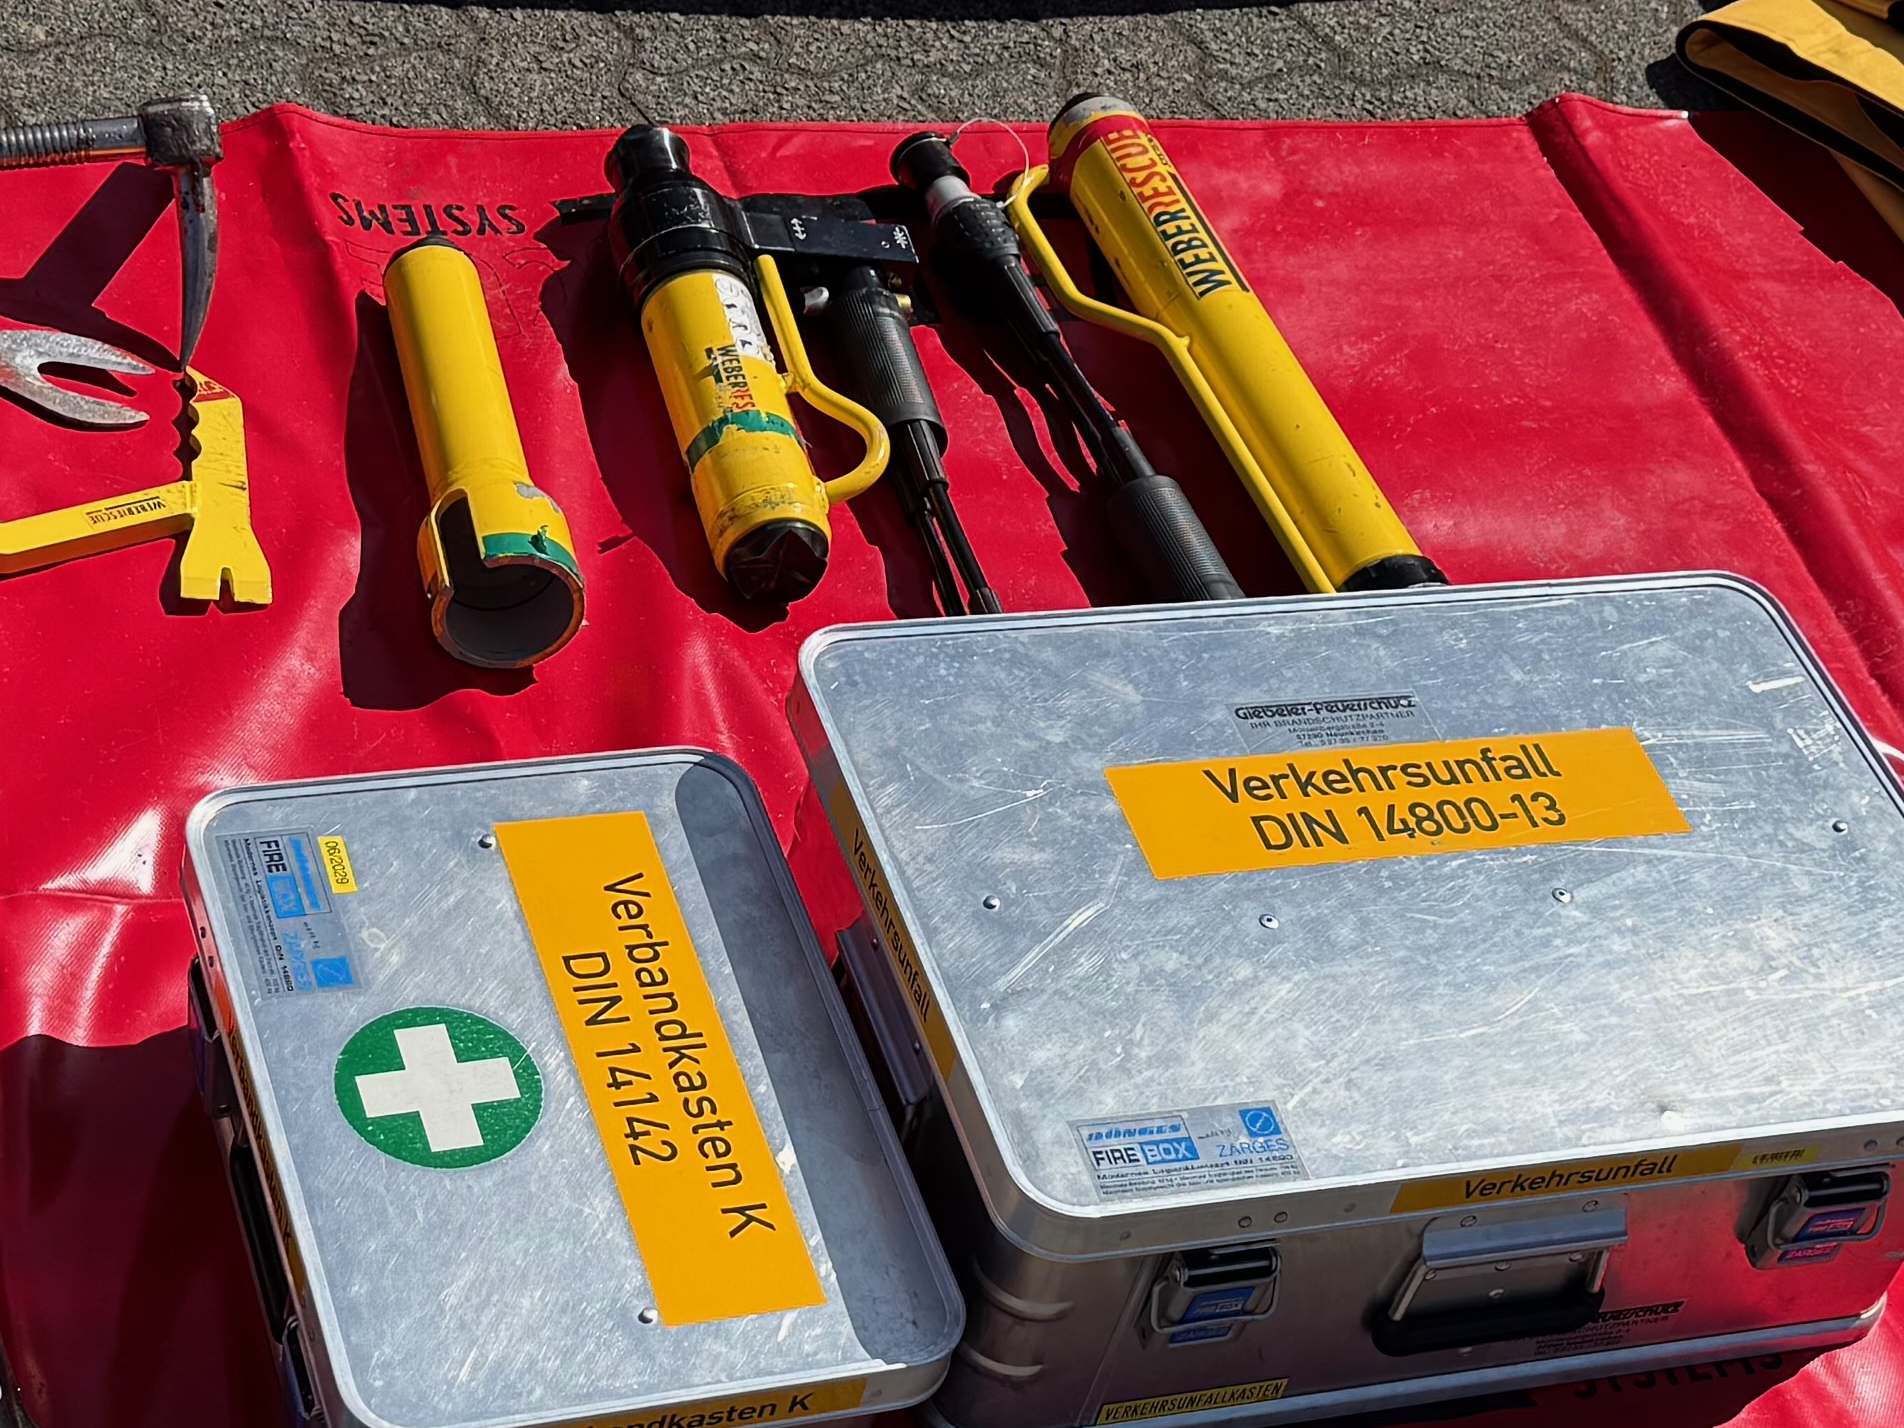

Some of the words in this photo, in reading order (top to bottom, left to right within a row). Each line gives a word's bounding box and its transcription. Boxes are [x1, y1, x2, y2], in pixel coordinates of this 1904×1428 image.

[330, 191, 527, 238] SYSTEMS
[1104, 127, 1236, 299] WEBERRESCUE
[716, 343, 756, 411] WEBERRES
[87, 495, 170, 527] WEBERRESCUE
[1202, 743, 1563, 805] Verkehrsunfall
[1250, 808, 1350, 853] DIN
[1356, 791, 1568, 843] 14800-13
[259, 839, 288, 874] FIRE
[854, 827, 932, 1024] Verkehrsunfall
[561, 951, 631, 1027] DIN
[603, 871, 744, 1189] Verbandkasten
[719, 1202, 777, 1240] K
[594, 1042, 679, 1167] 14142
[1092, 1146, 1142, 1167] FIRE
[1146, 1141, 1194, 1162] BOX
[1216, 1138, 1291, 1158] ZARGES
[1464, 1154, 1678, 1200] Verkehrsunfall
[787, 1391, 816, 1413] K
[1104, 1381, 1284, 1421] VERKEHRSUNFALLKASTEN
